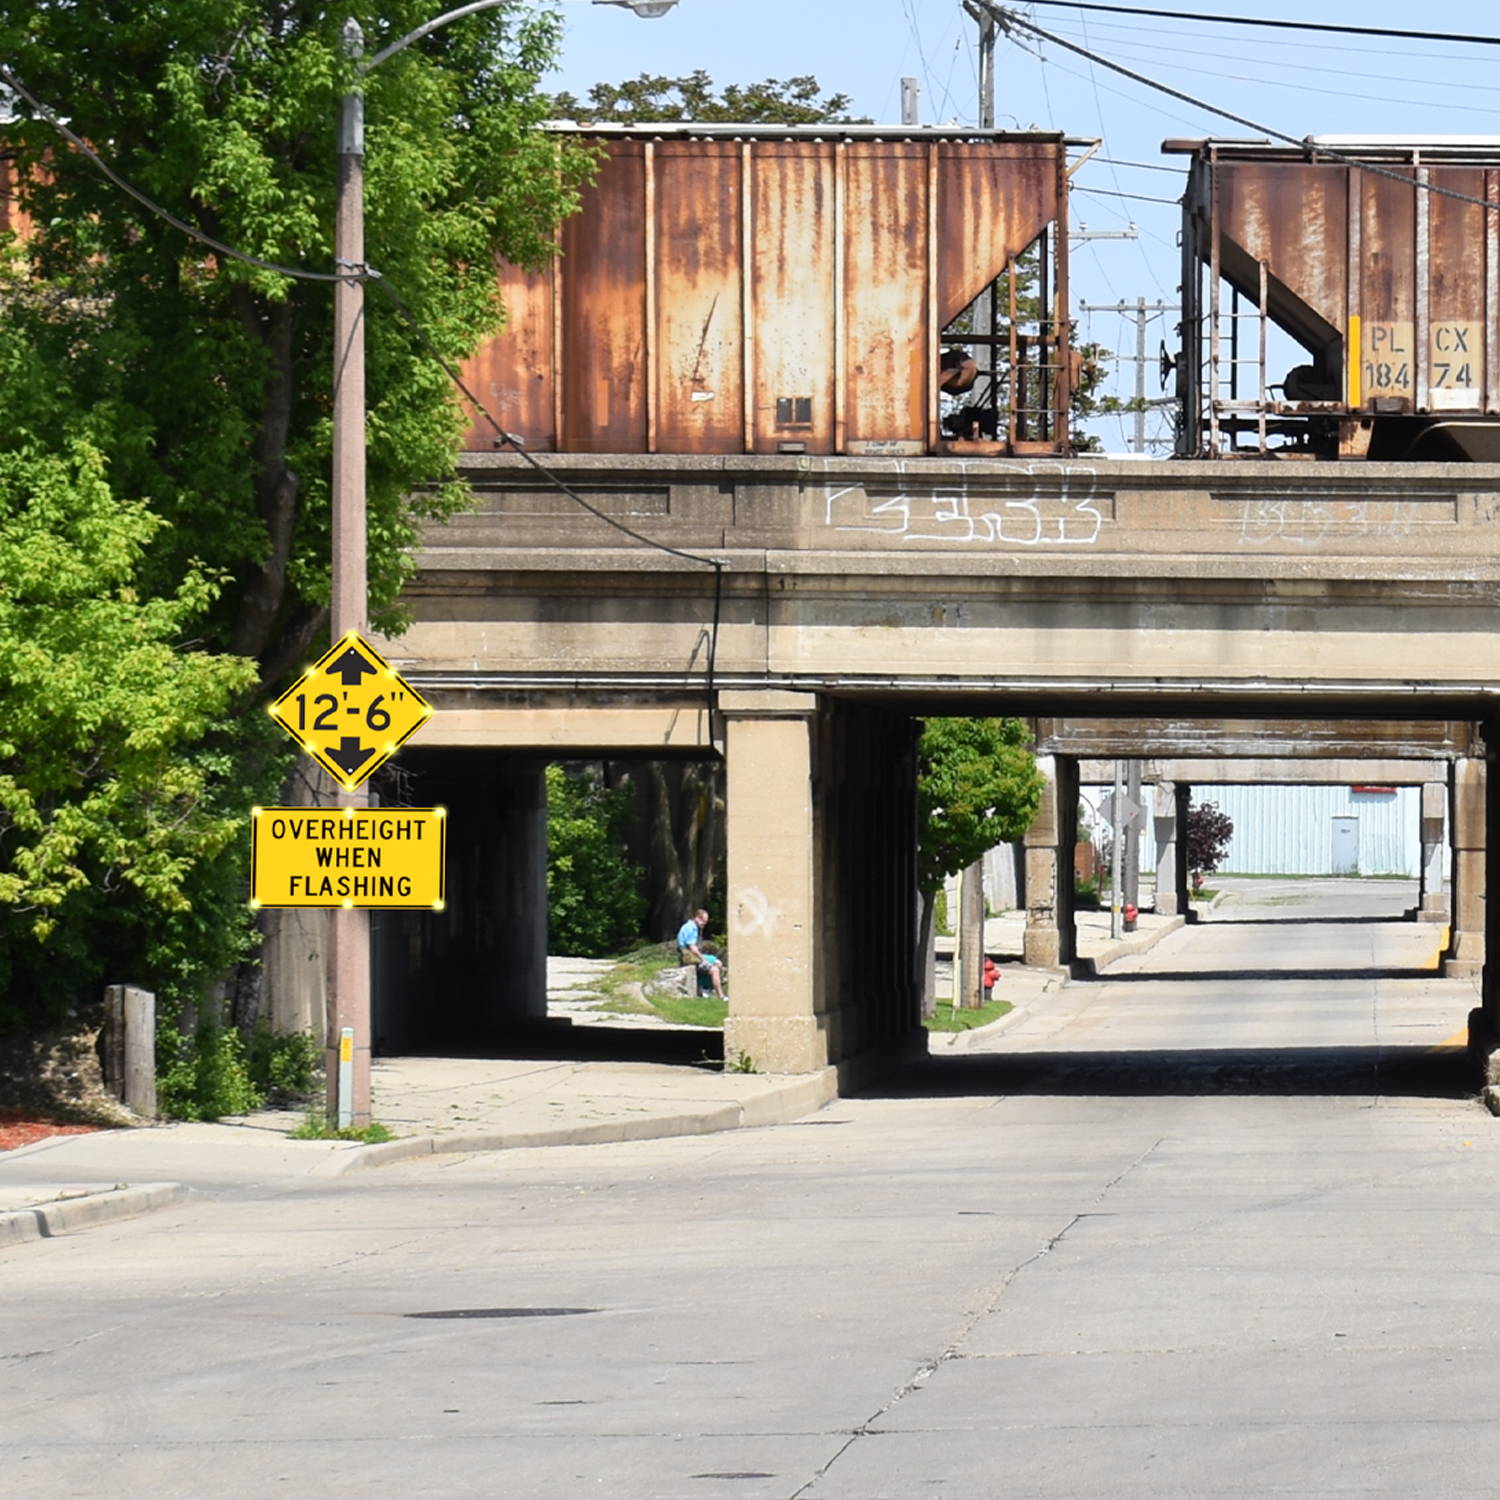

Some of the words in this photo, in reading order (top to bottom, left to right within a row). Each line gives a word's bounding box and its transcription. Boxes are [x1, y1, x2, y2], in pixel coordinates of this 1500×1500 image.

[1371, 326, 1405, 353] PL
[1435, 327, 1469, 353] CX
[1365, 362, 1410, 389] 184
[1433, 362, 1472, 389] 74
[271, 818, 427, 841] OVERHEIGHT
[315, 847, 382, 868] WHEN
[289, 875, 412, 897] FLASHING
